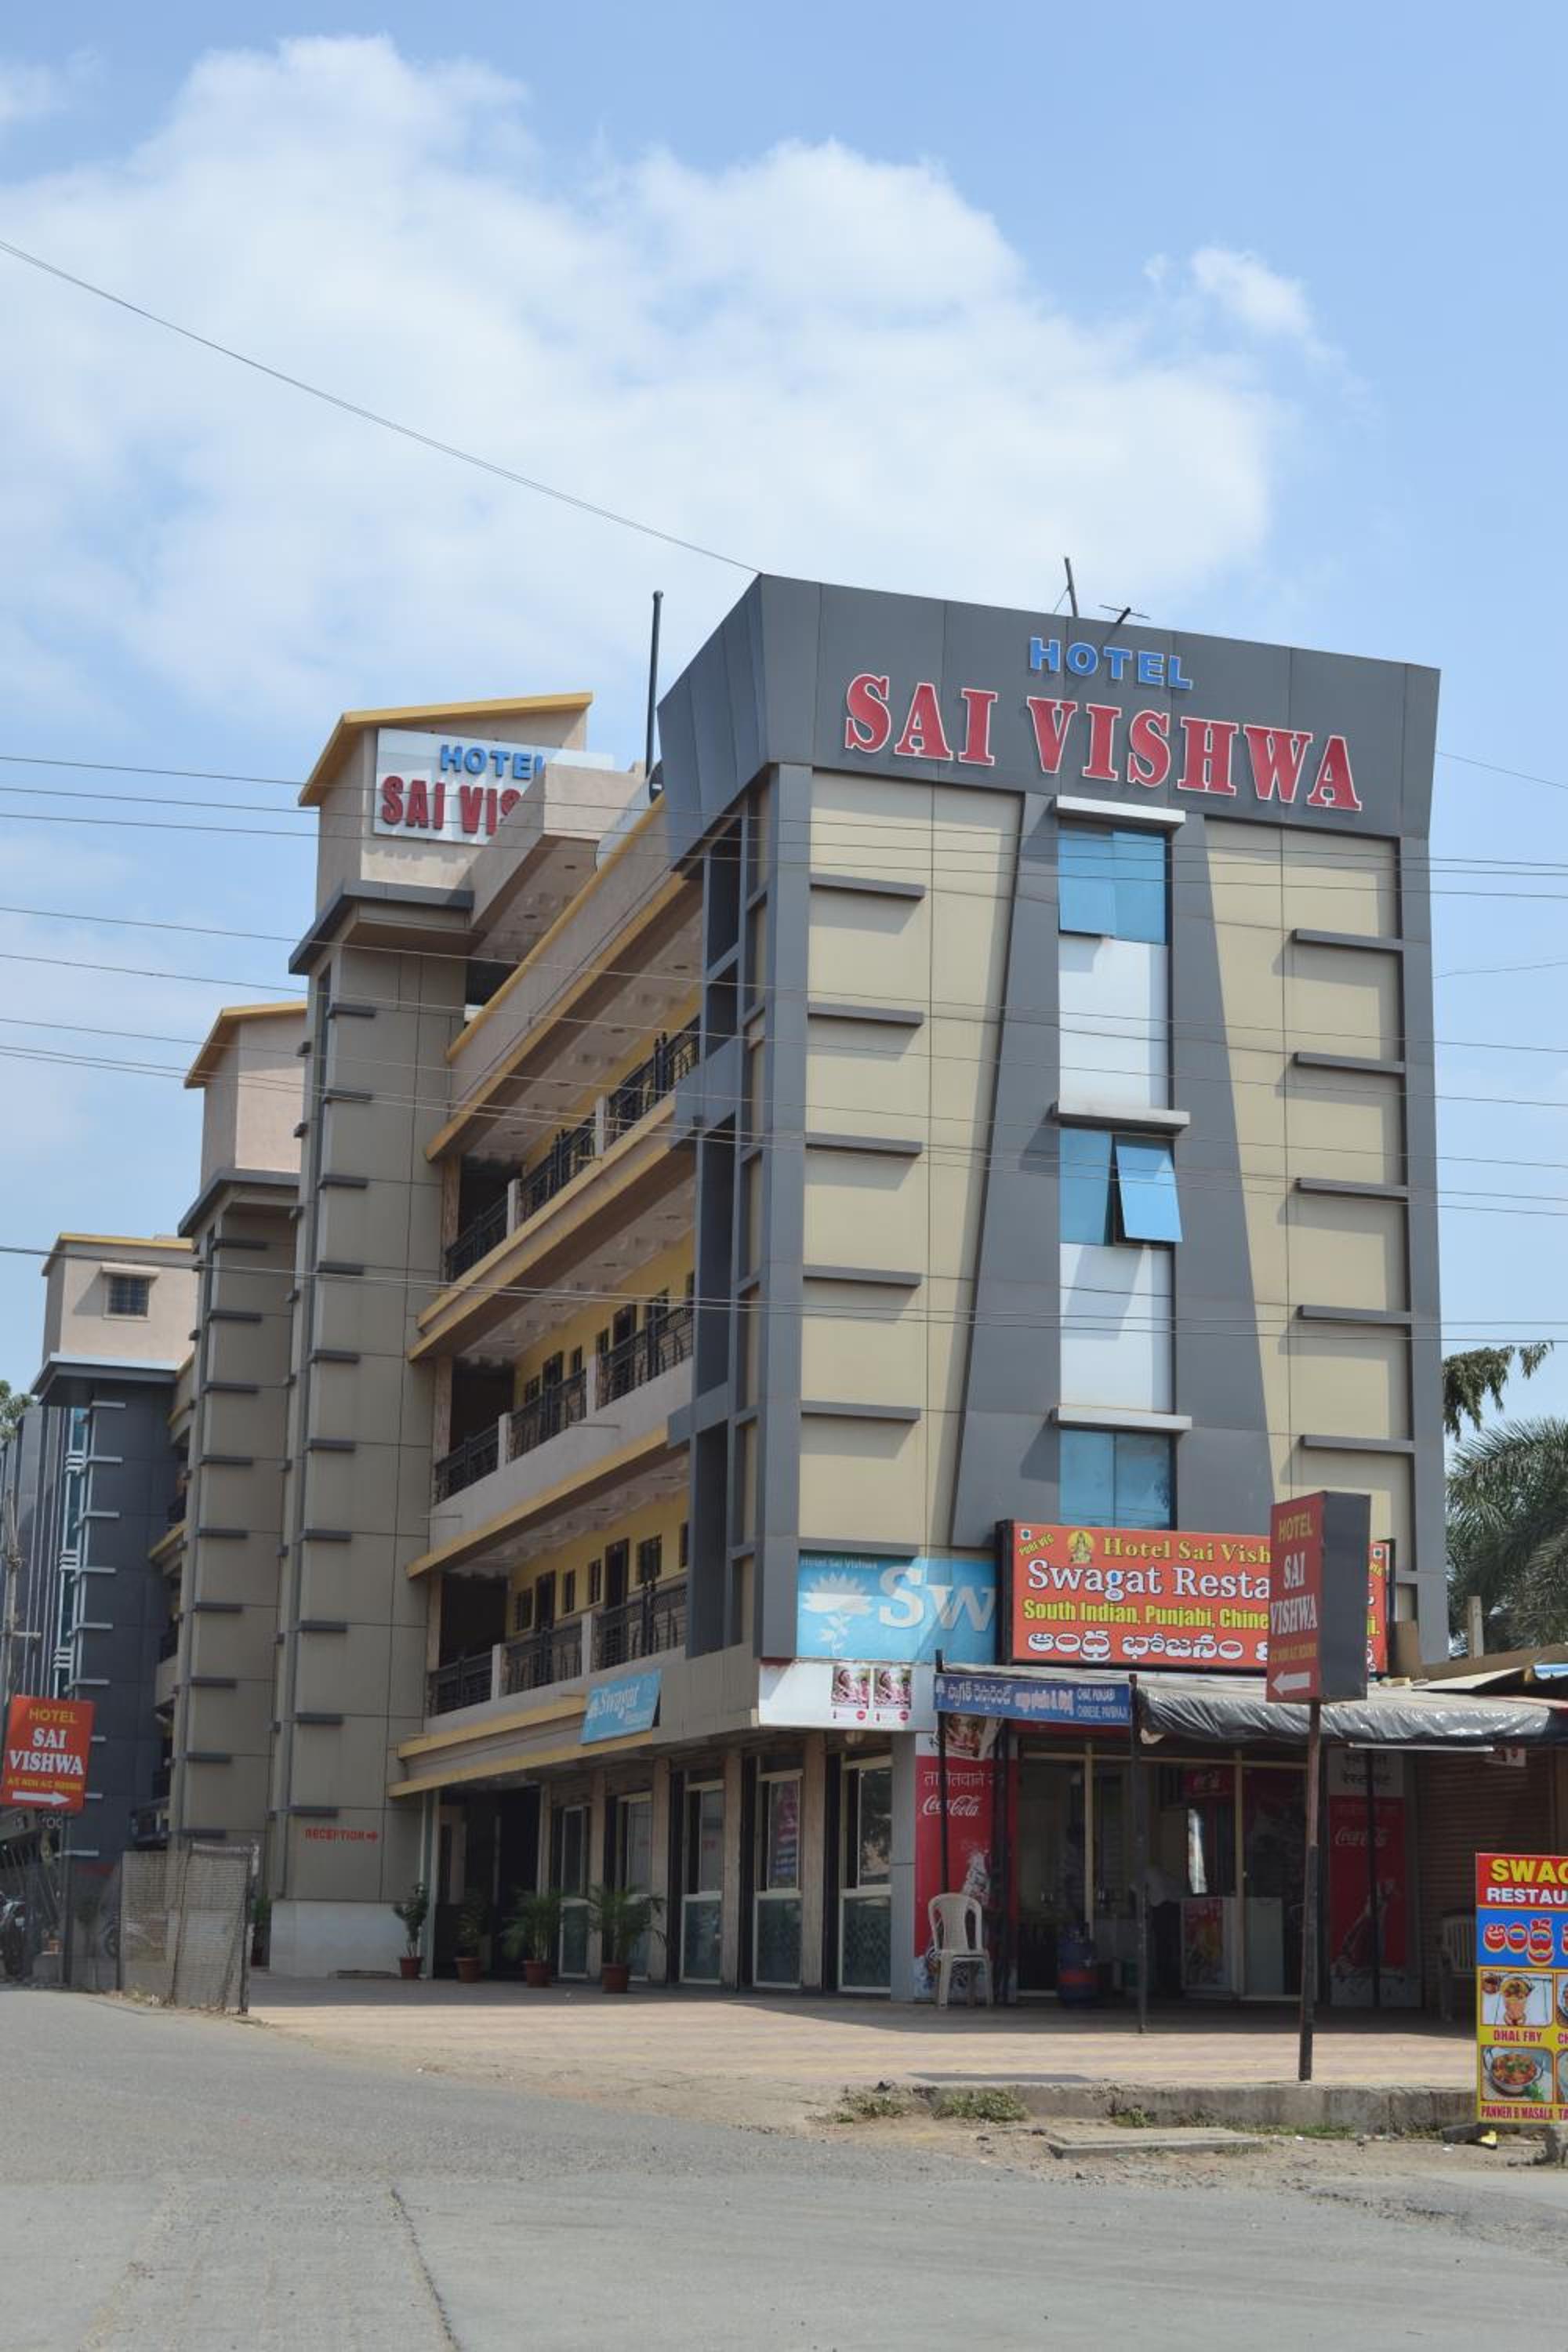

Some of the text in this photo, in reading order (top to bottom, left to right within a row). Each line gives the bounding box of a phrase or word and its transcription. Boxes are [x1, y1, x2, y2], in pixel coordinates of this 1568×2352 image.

[1029, 637, 1192, 689] HOTEL
[844, 674, 1362, 811] SAI VISHWA
[381, 775, 445, 829] SAI
[1279, 1512, 1312, 1543] HOTEL
[1103, 1537, 1171, 1559] Hotel
[1178, 1542, 1214, 1562] Sai
[1028, 1559, 1164, 1601] Swagat
[1283, 1552, 1305, 1589] SAI
[1024, 1599, 1076, 1621] South
[1080, 1601, 1142, 1626] Indian,
[1145, 1605, 1216, 1629] Punjabi,
[1270, 1593, 1317, 1635] VISHWA
[29, 1708, 77, 1723] HOTEL
[33, 1727, 67, 1749] SAI
[9, 1750, 84, 1775] VISHWA
[1494, 2029, 1543, 2042] DHAL FRY
